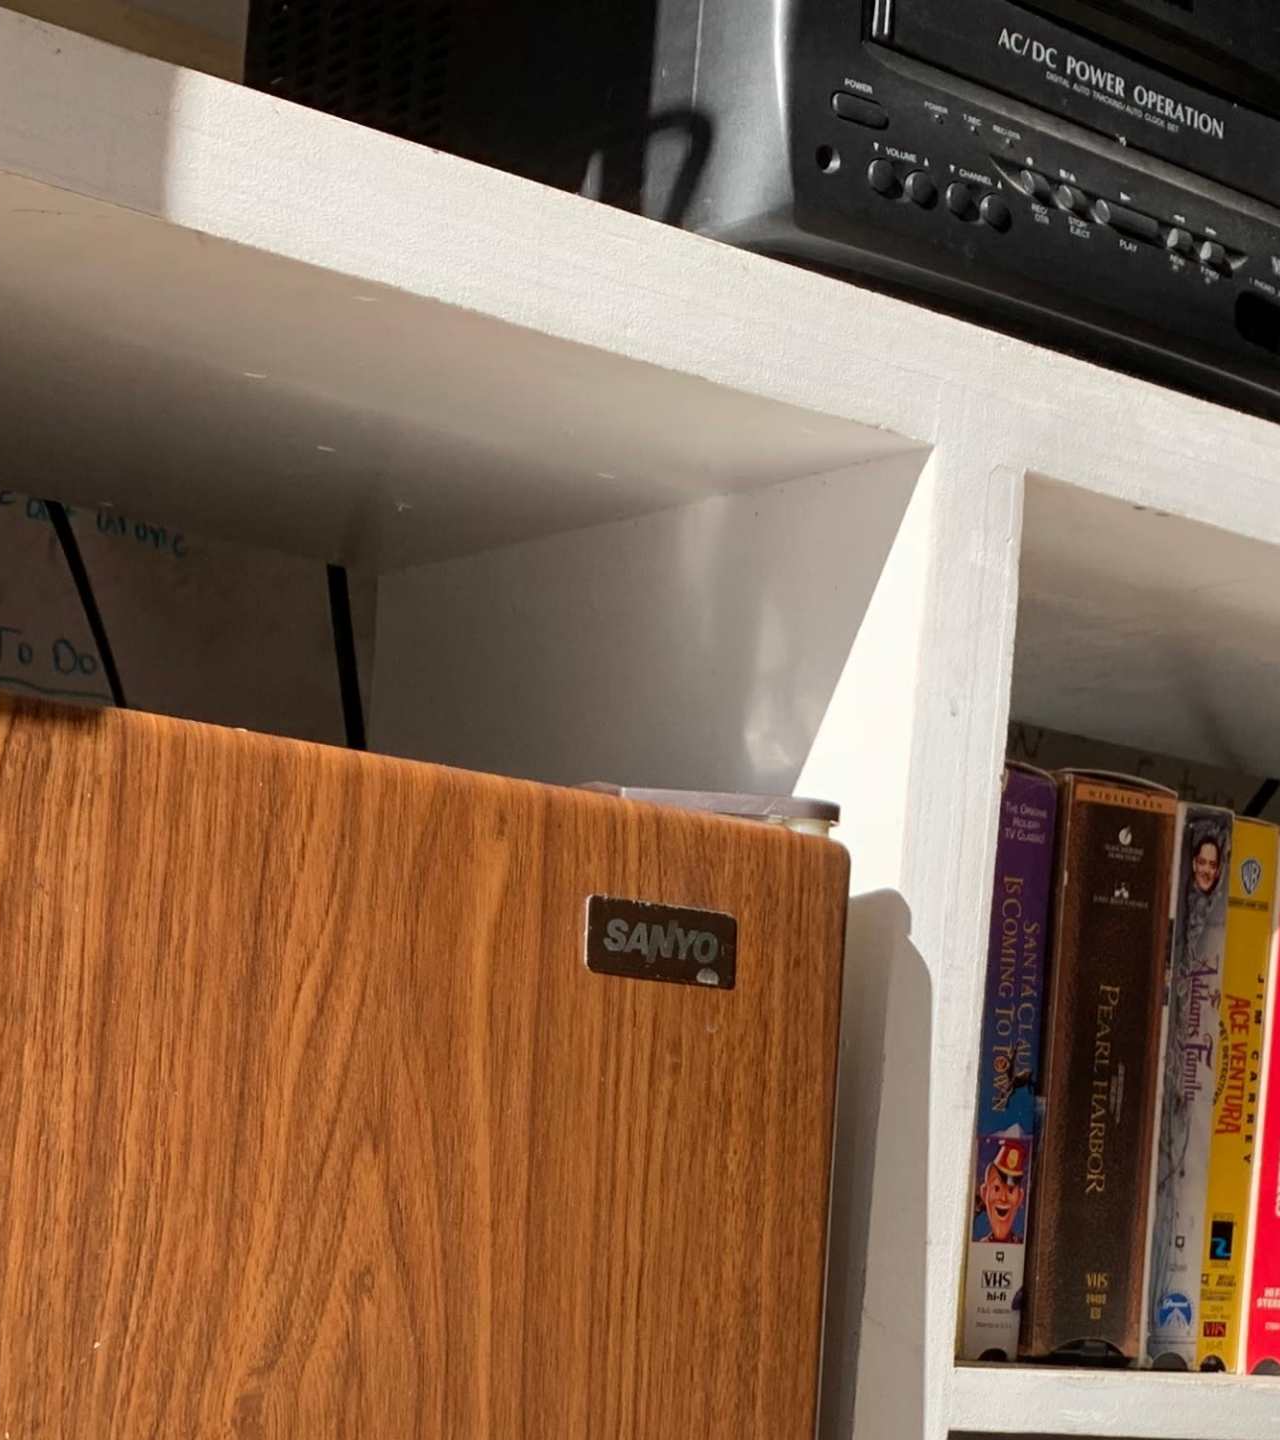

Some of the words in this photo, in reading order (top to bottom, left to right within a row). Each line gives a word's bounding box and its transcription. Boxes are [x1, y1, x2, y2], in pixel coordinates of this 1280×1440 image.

[844, 78, 873, 94] POWER
[998, 28, 1058, 68] AC/DC
[1066, 56, 1125, 97] POWER
[1133, 85, 1224, 139] OPERATION
[1046, 71, 1069, 88] DIGITAL
[1073, 82, 1090, 96] AUTO
[924, 101, 948, 115] POWER
[885, 146, 918, 163] VOLUME
[959, 168, 993, 186] CHANNEL
[1120, 239, 1138, 252] PLAY
[52, 639, 97, 675] Do
[1004, 876, 1023, 894] IS
[603, 918, 719, 964] SANYO
[999, 900, 1022, 998] COMING
[1020, 920, 1040, 1000] SANTA
[1179, 955, 1219, 1037] Addams
[1226, 994, 1251, 1036] ACE
[1256, 974, 1265, 1025] JIM
[996, 1006, 1014, 1036] TO
[1094, 984, 1119, 1072] PEARL
[992, 1045, 1014, 1112] TOWN
[1215, 1042, 1248, 1136] VENTURA
[1244, 1050, 1260, 1165] CARREY
[1085, 1080, 1110, 1194] HARBOR
